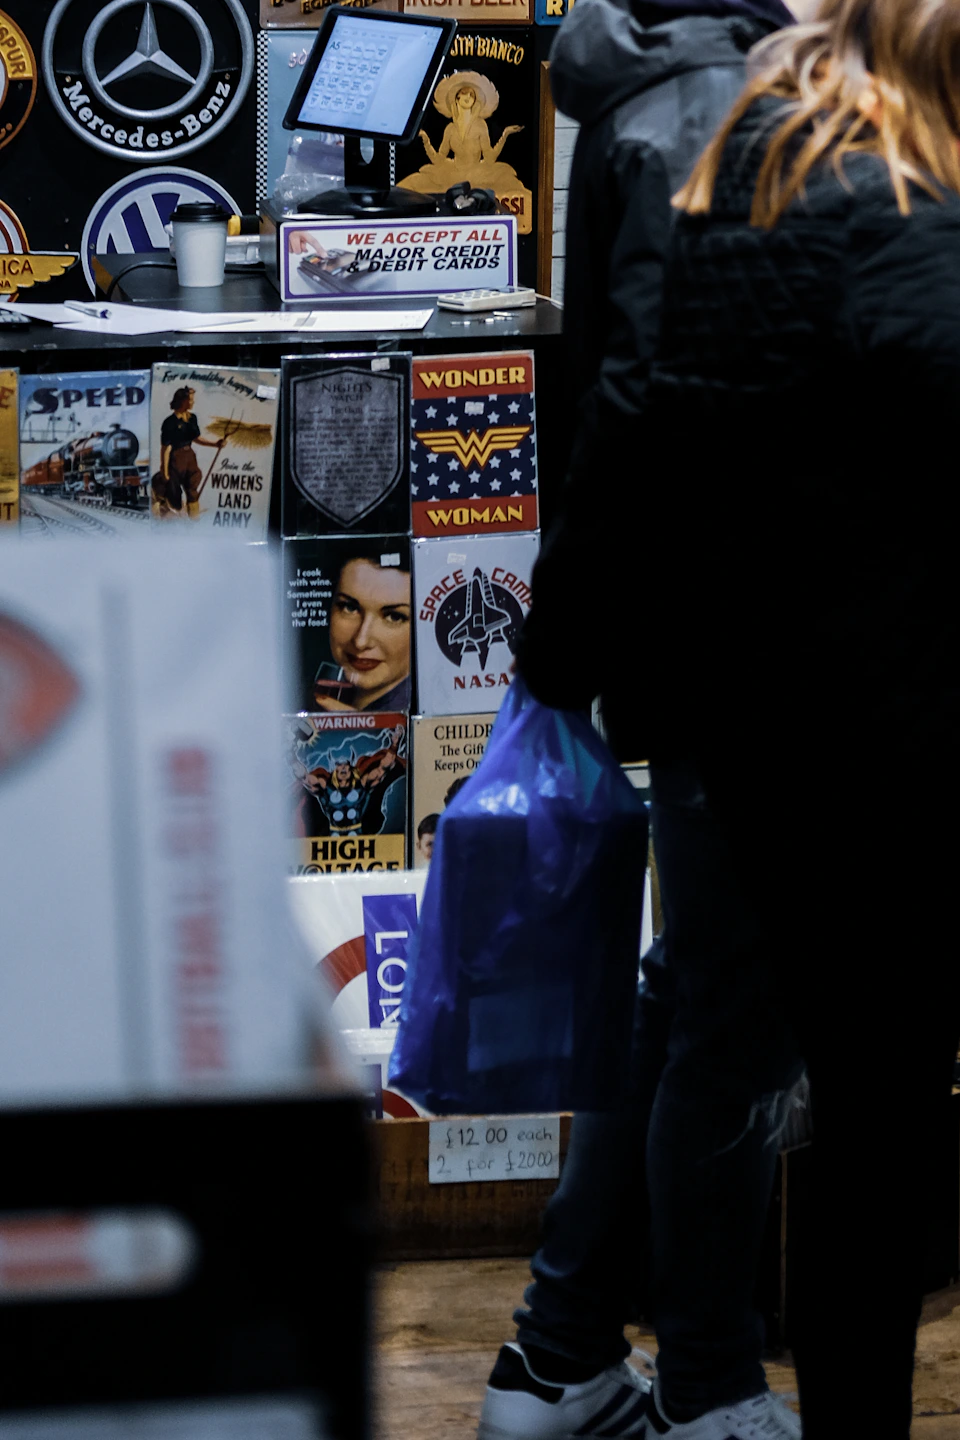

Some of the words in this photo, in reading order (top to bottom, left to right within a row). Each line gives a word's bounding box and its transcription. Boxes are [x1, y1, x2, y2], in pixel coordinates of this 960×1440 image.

[477, 35, 525, 66] BIANCO
[63, 80, 231, 148] Mercedes-Benz
[347, 233, 377, 245] WE
[383, 231, 462, 245] ACCEPT
[466, 229, 502, 242] ALL
[355, 247, 425, 261] MAJOR
[431, 245, 505, 258] CREDIT
[347, 262, 361, 273] &
[373, 259, 430, 273] DEBIT
[433, 257, 500, 270] CARDS
[162, 371, 177, 382] For
[419, 366, 526, 389] WONDER
[33, 386, 146, 415] SPEED
[221, 460, 239, 471] Join
[210, 473, 263, 492] WOMEN'S
[218, 492, 251, 509] LAND
[213, 511, 252, 529] ARMY
[427, 505, 522, 527] WOMAN
[302, 568, 321, 577] cook
[289, 578, 308, 587] with
[287, 590, 332, 599] Sometimes
[419, 569, 466, 622] SPACE
[453, 673, 510, 690] NASA
[314, 716, 375, 729] WARNING
[440, 745, 460, 756] The
[463, 744, 485, 756] Gift
[434, 760, 463, 772] Keeps
[311, 840, 376, 861] HIGH
[517, 1126, 552, 1142] each
[437, 1157, 451, 1174] 2
[466, 1154, 495, 1178] for
